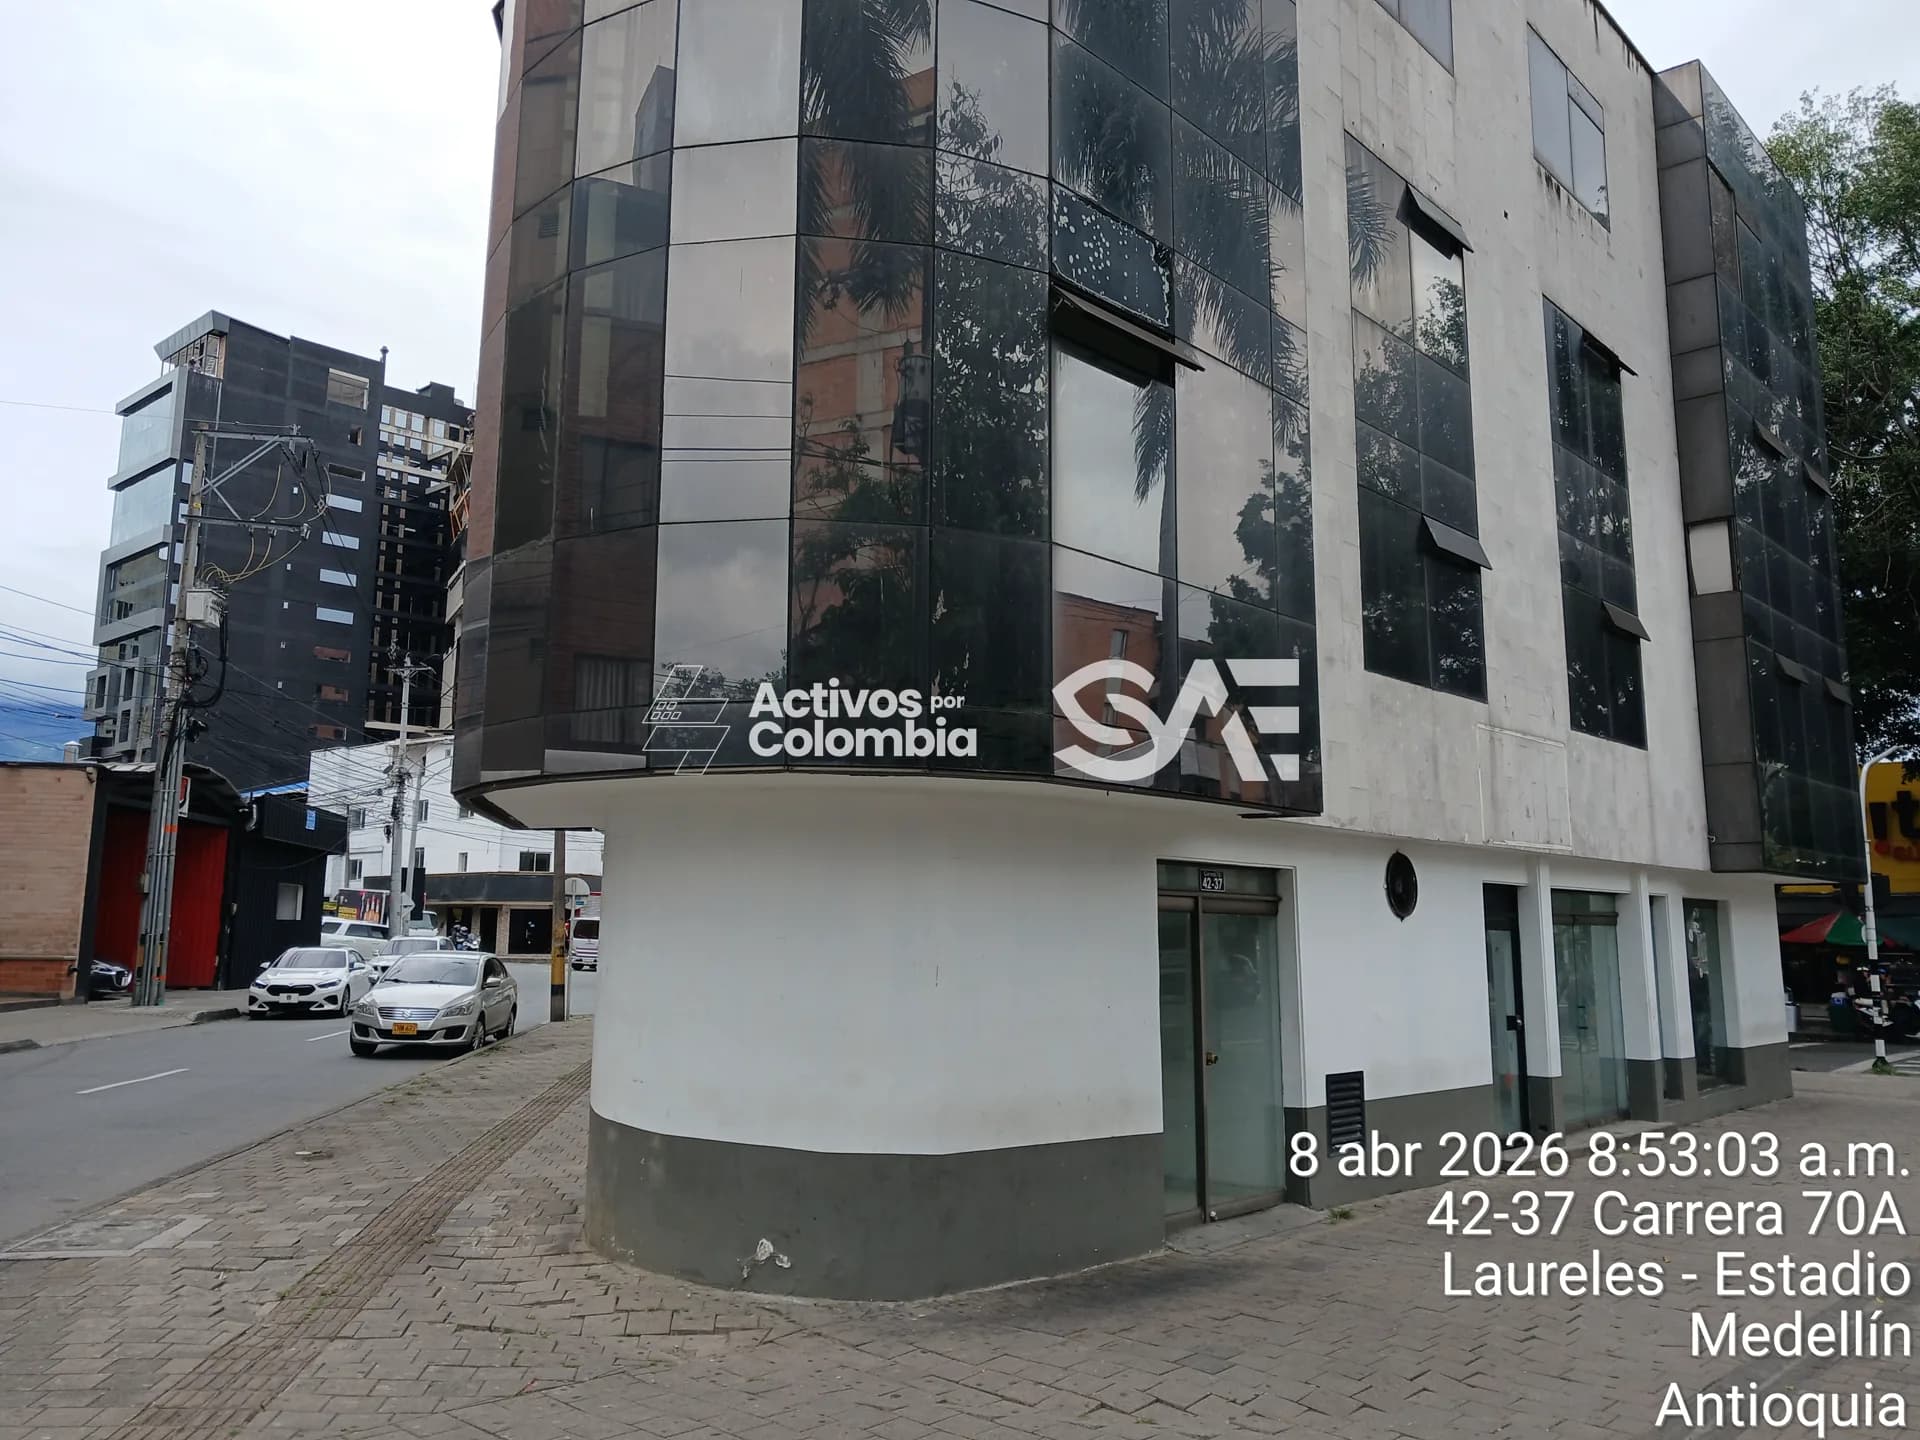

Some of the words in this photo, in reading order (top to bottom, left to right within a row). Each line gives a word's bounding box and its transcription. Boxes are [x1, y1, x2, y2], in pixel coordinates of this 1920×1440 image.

[748, 677, 923, 719] Activos
[930, 695, 966, 714] por
[748, 716, 978, 758] Colombia
[1052, 658, 1300, 782] SAE
